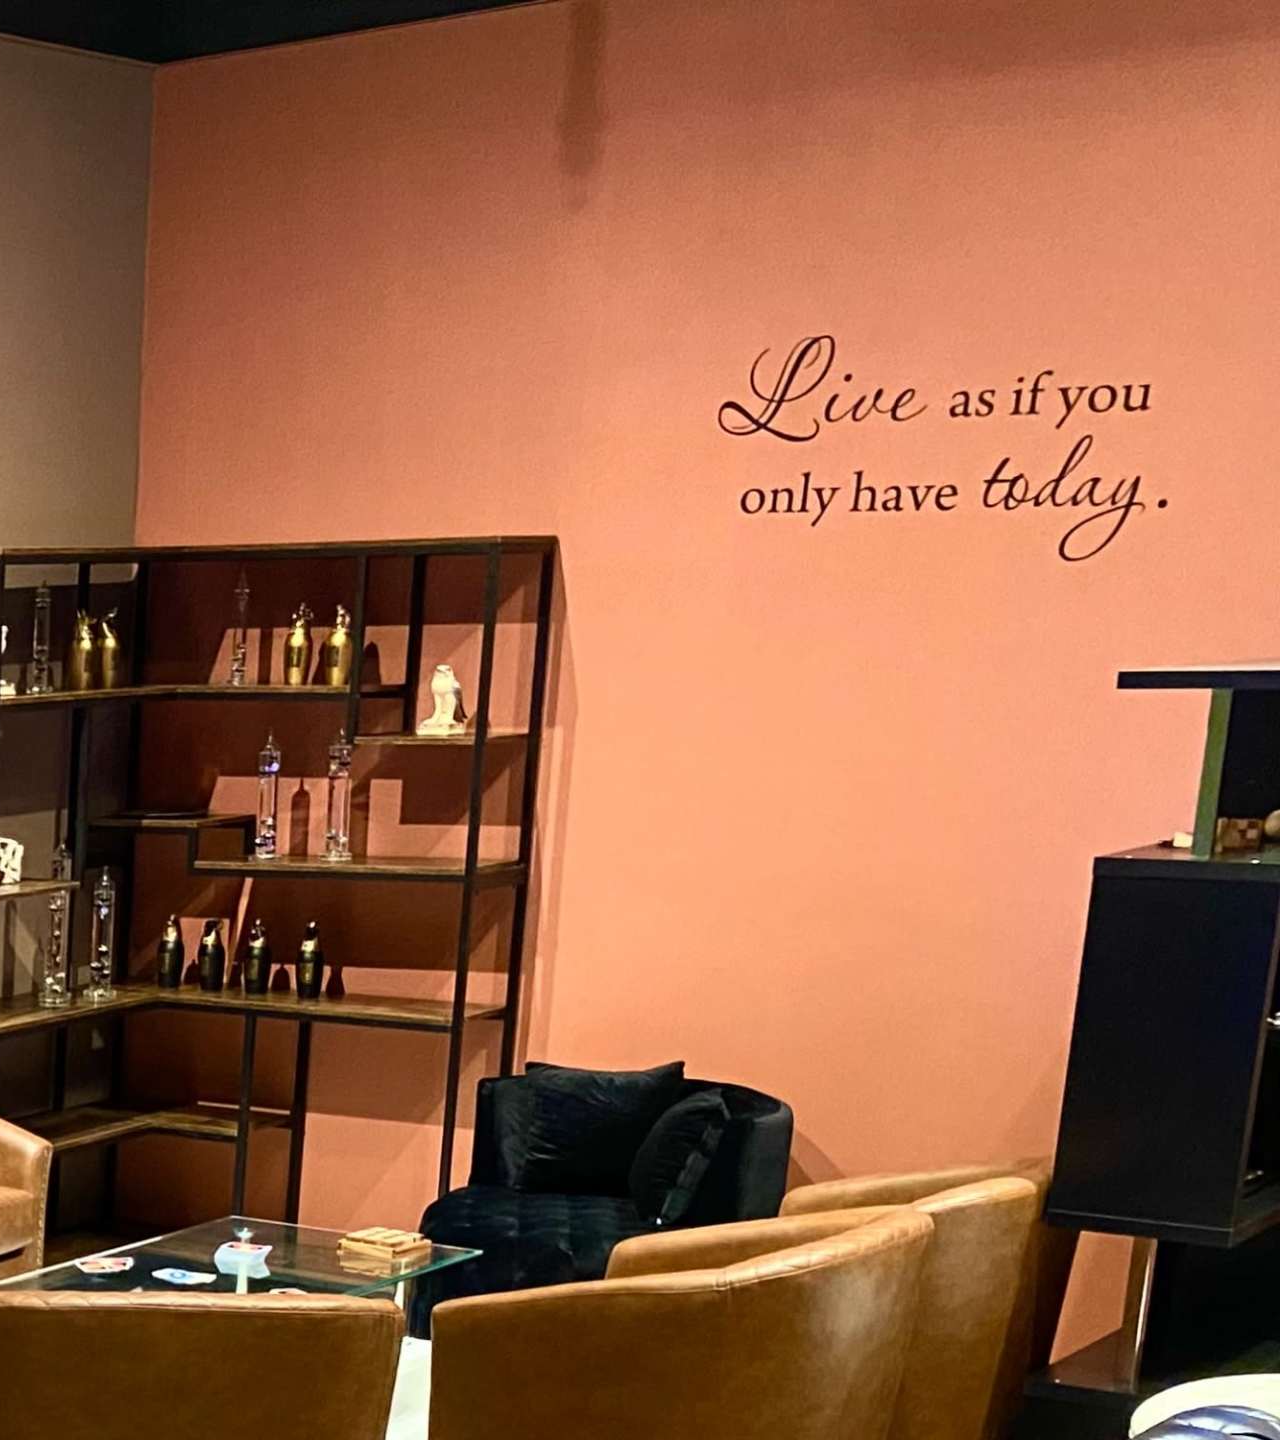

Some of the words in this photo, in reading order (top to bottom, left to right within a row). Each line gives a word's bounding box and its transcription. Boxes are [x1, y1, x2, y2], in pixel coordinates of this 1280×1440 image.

[717, 334, 928, 443] Live
[948, 387, 996, 418] as
[1009, 369, 1055, 416] if
[1054, 381, 1153, 430] you
[739, 470, 840, 528] only
[848, 470, 959, 514] have
[982, 434, 1169, 562] today.
